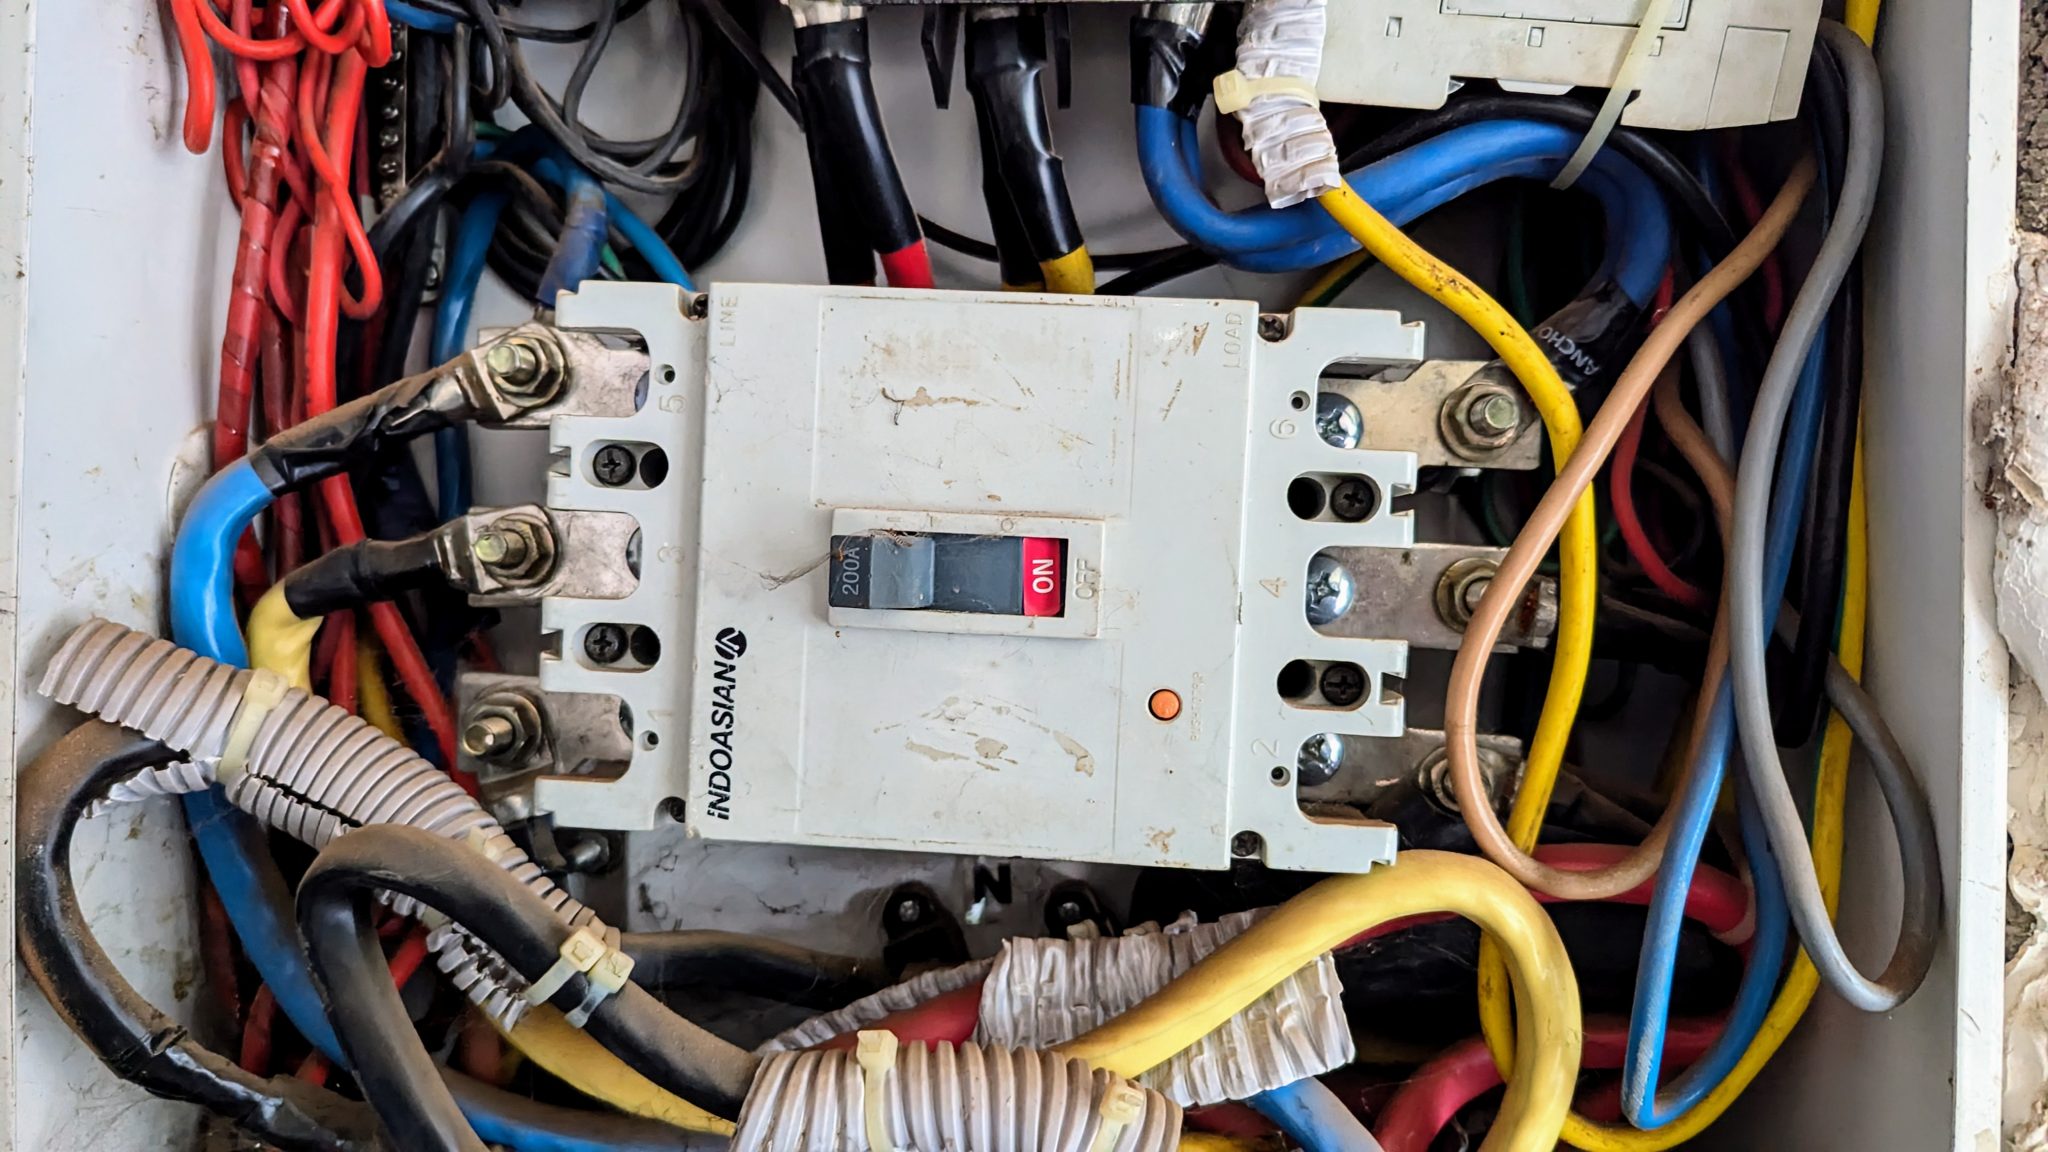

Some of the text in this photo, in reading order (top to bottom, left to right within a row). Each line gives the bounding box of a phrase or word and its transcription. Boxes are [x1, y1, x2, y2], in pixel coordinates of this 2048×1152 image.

[1223, 311, 1243, 368] LOAD
[658, 394, 686, 415] 5
[1269, 418, 1296, 440] 6
[841, 547, 861, 596] 200A
[1032, 558, 1054, 594] ON
[1074, 557, 1096, 600] OFF
[1259, 577, 1287, 599] 4
[1250, 738, 1279, 759] 2
[973, 862, 1012, 904] N
